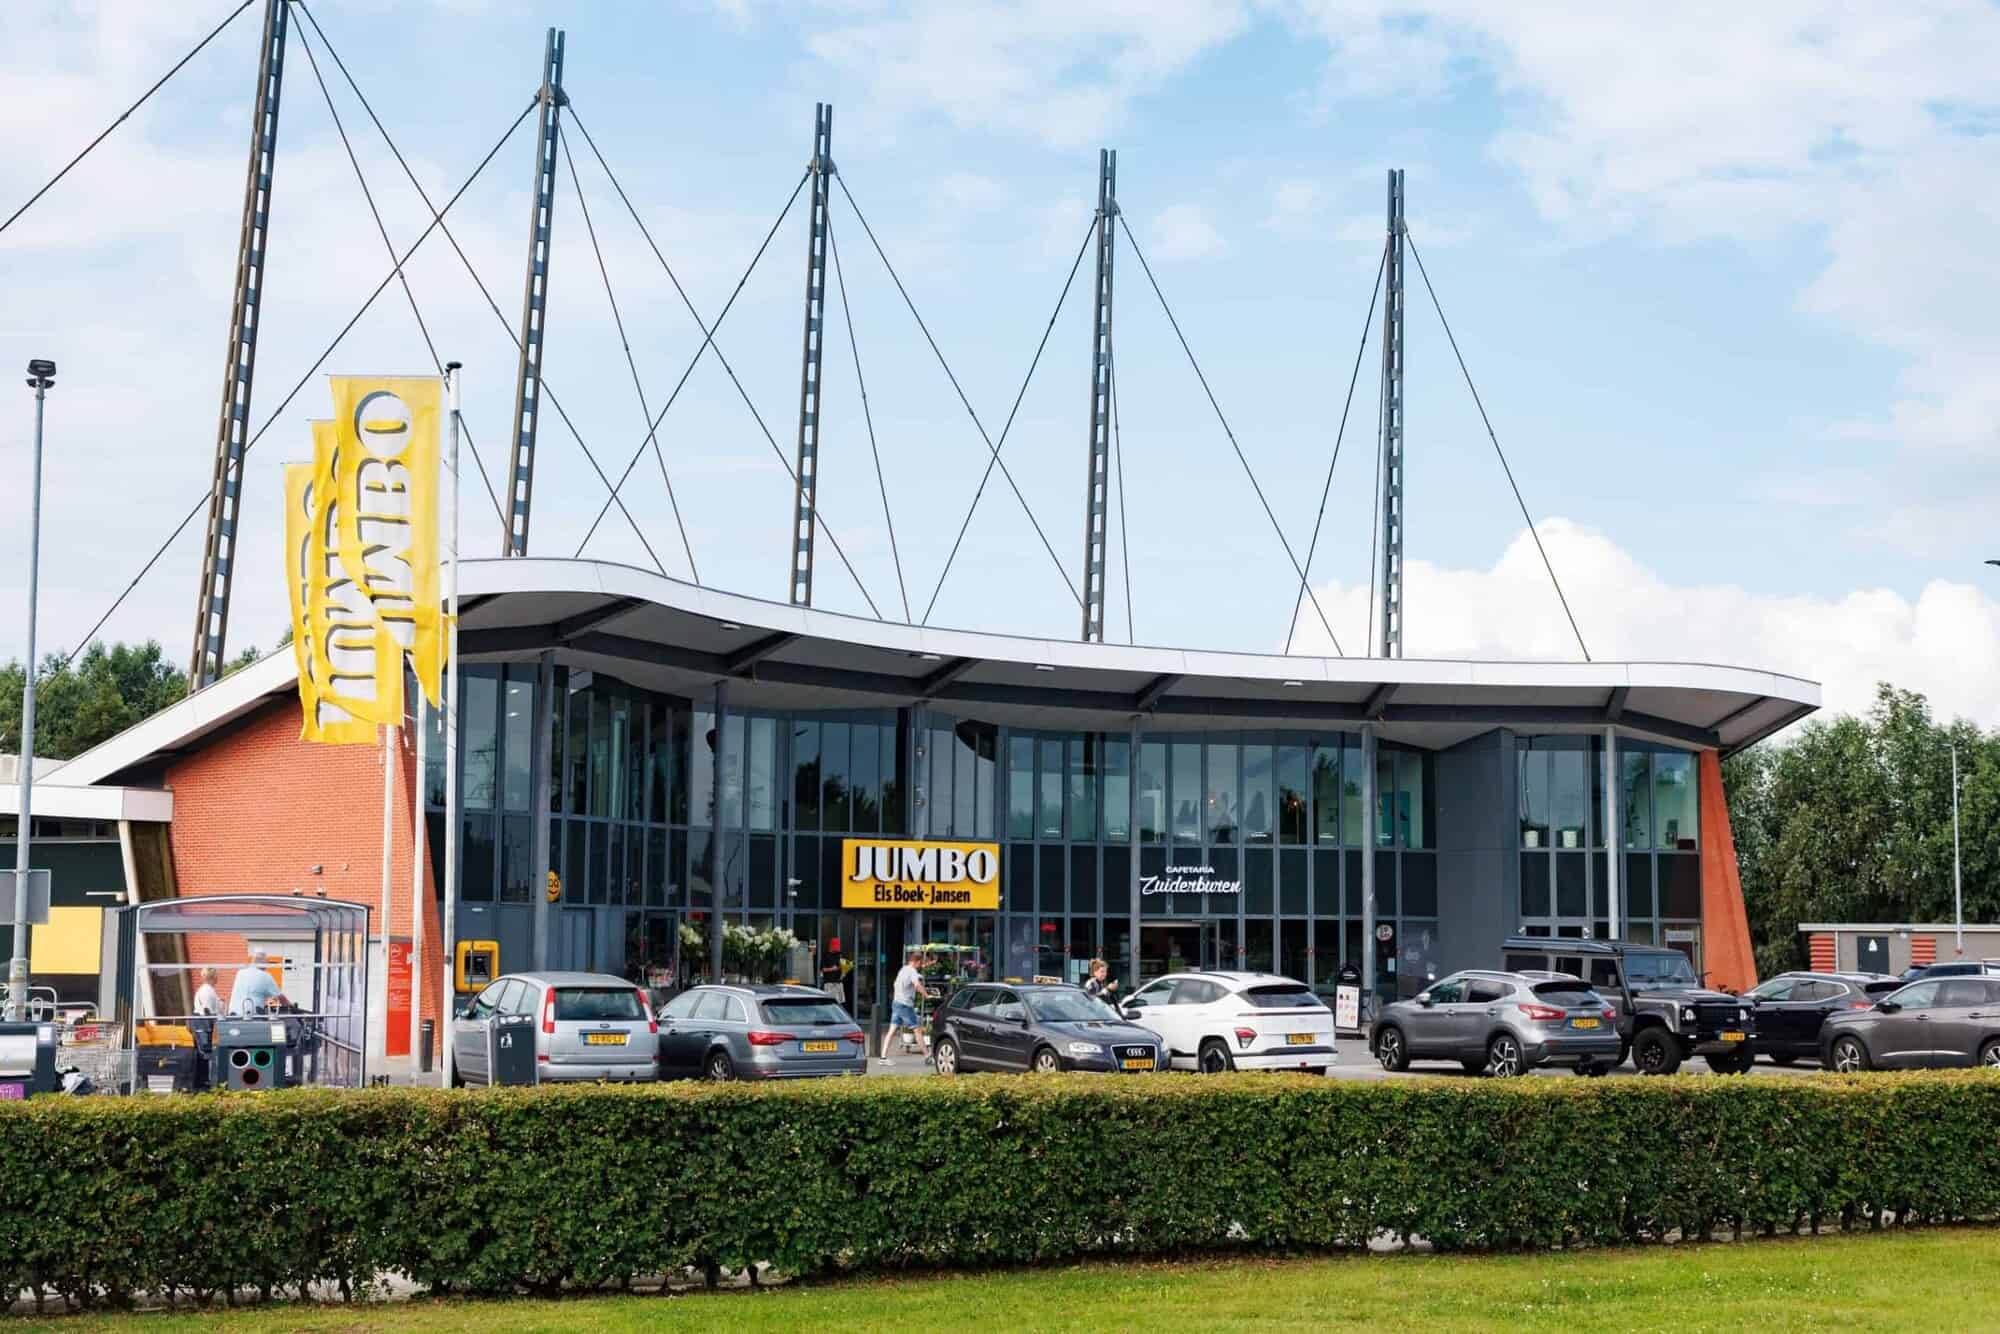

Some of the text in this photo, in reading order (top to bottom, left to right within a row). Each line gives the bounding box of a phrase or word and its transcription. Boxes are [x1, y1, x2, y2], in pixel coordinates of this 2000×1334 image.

[850, 846, 996, 883] JUMBO
[874, 884, 971, 904] Els Boek-Jansen
[1140, 876, 1241, 895] Zuiderburen
